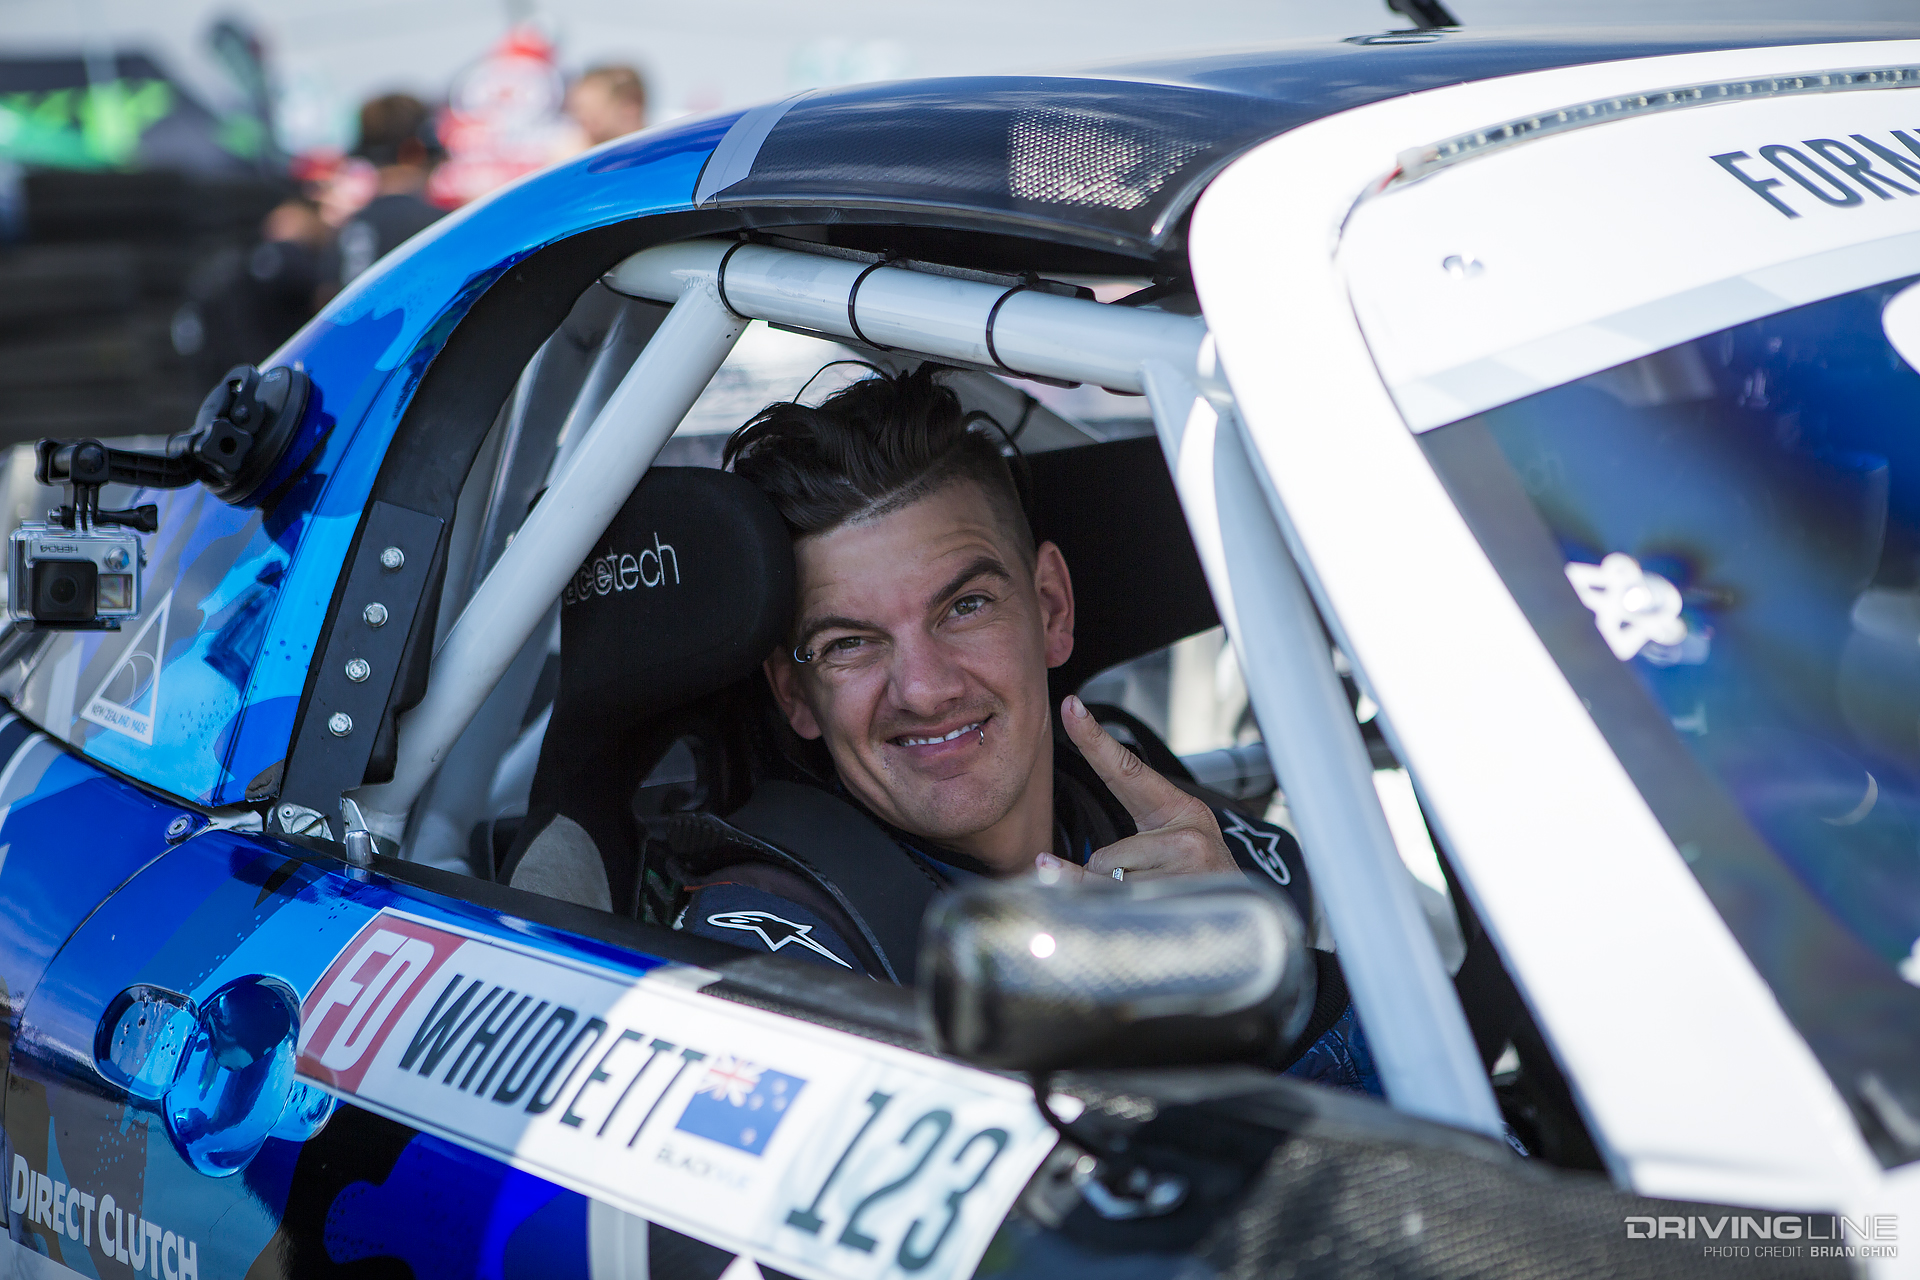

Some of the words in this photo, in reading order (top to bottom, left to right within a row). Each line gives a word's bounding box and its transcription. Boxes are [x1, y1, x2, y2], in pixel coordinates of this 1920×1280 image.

[1708, 128, 1920, 220] FORM
[130, 718, 149, 736] MADE
[302, 928, 436, 1072] FD
[399, 974, 706, 1148] WHIDDETT
[10, 1153, 96, 1248] DIRECT
[98, 1193, 198, 1280] CLUTCH
[785, 1090, 1008, 1271] 123
